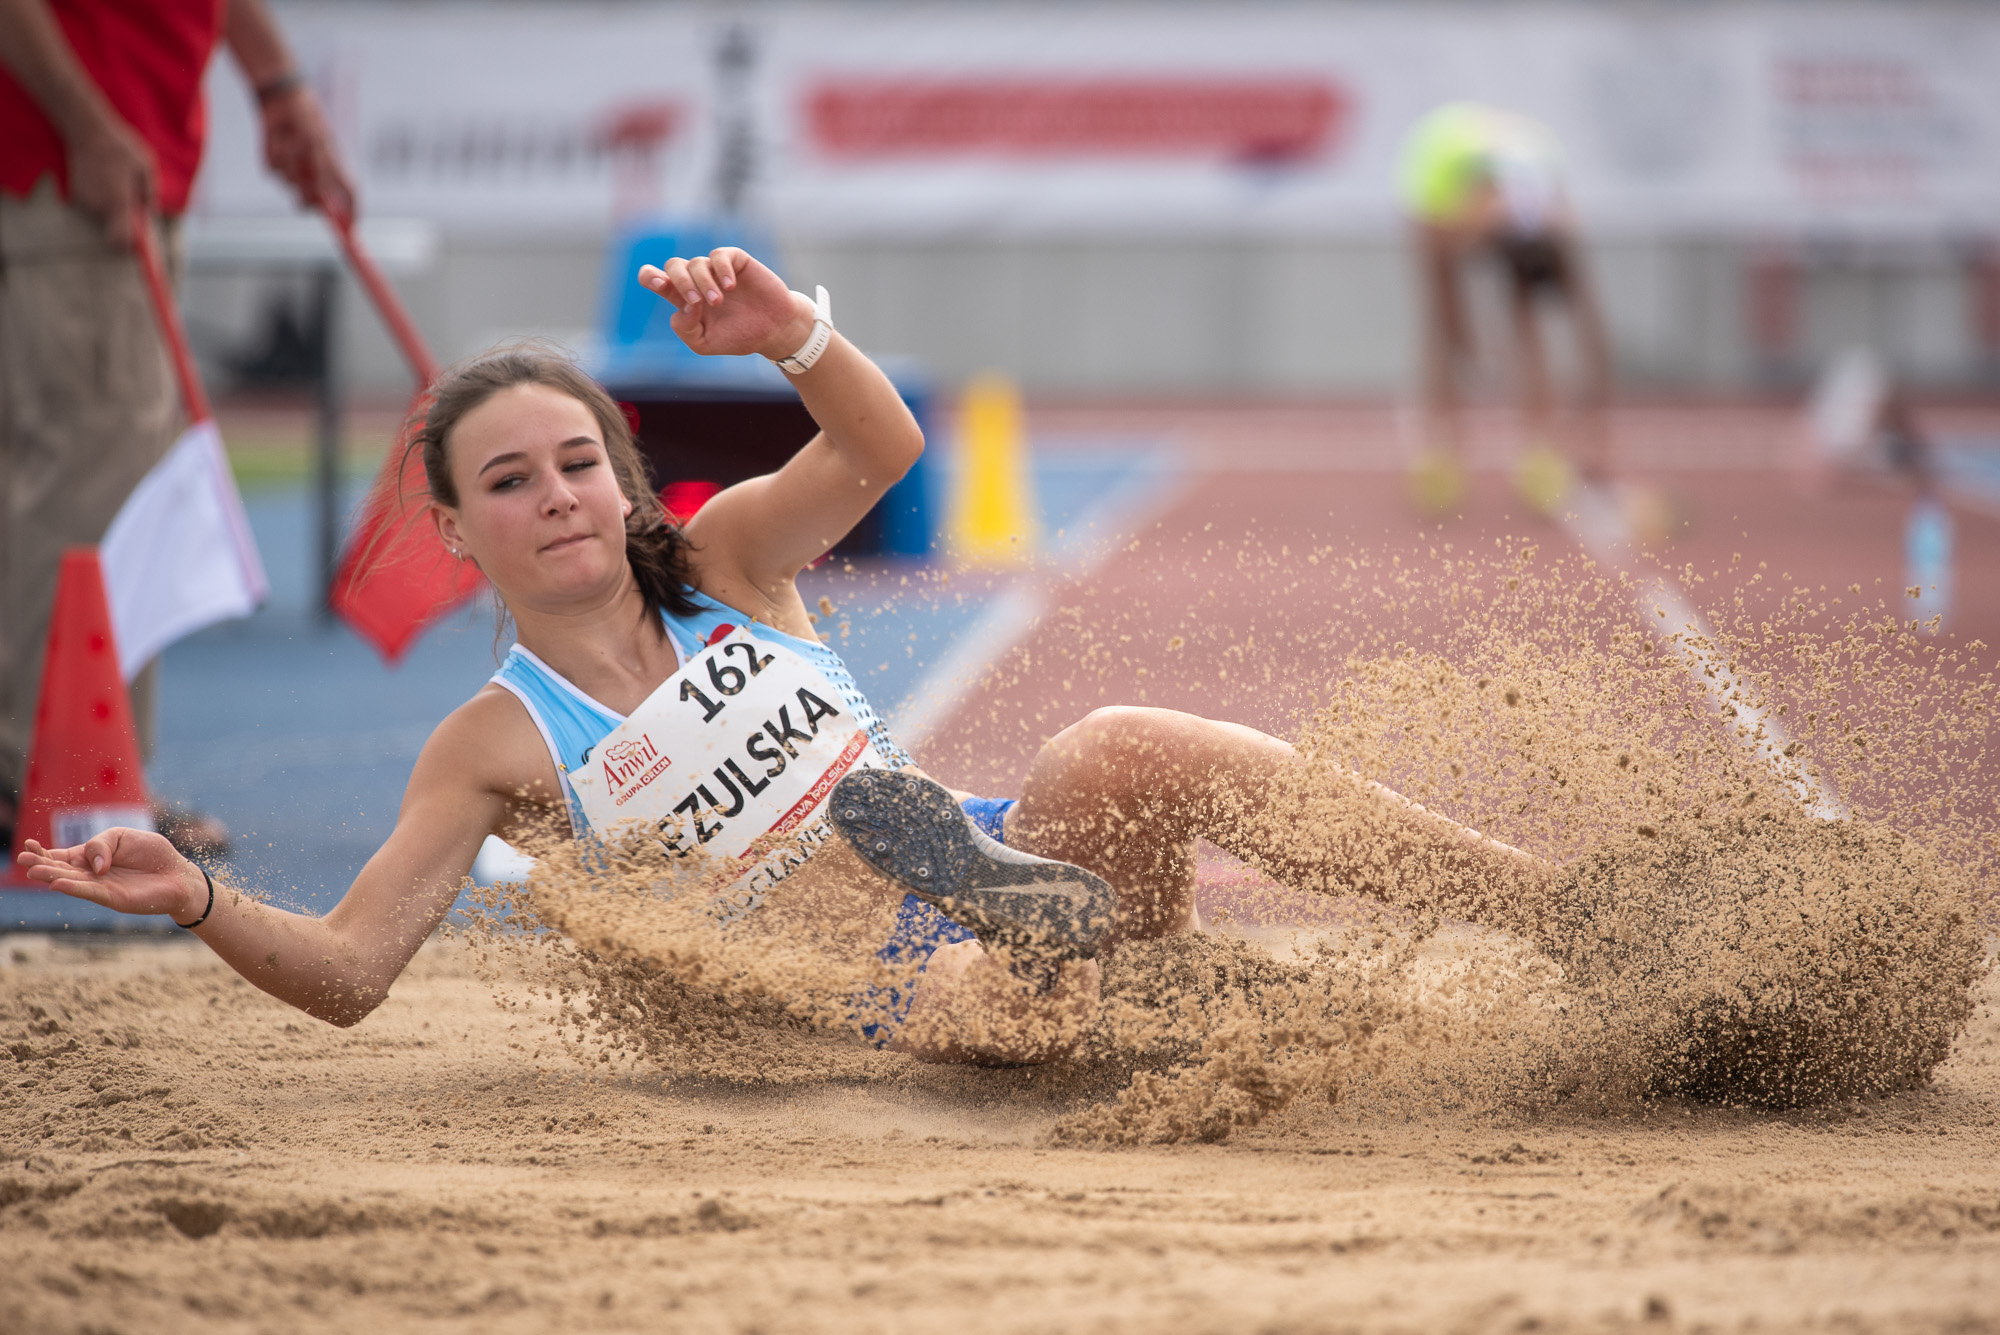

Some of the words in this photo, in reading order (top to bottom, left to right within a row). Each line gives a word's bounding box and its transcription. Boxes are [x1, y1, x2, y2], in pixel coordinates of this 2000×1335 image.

[679, 642, 776, 724] 162
[602, 733, 658, 796] Anwil
[615, 783, 643, 806] GRUPA
[641, 757, 670, 784] ORLEN
[638, 687, 840, 861] EZULSKA
[811, 761, 847, 800] POLSKI
